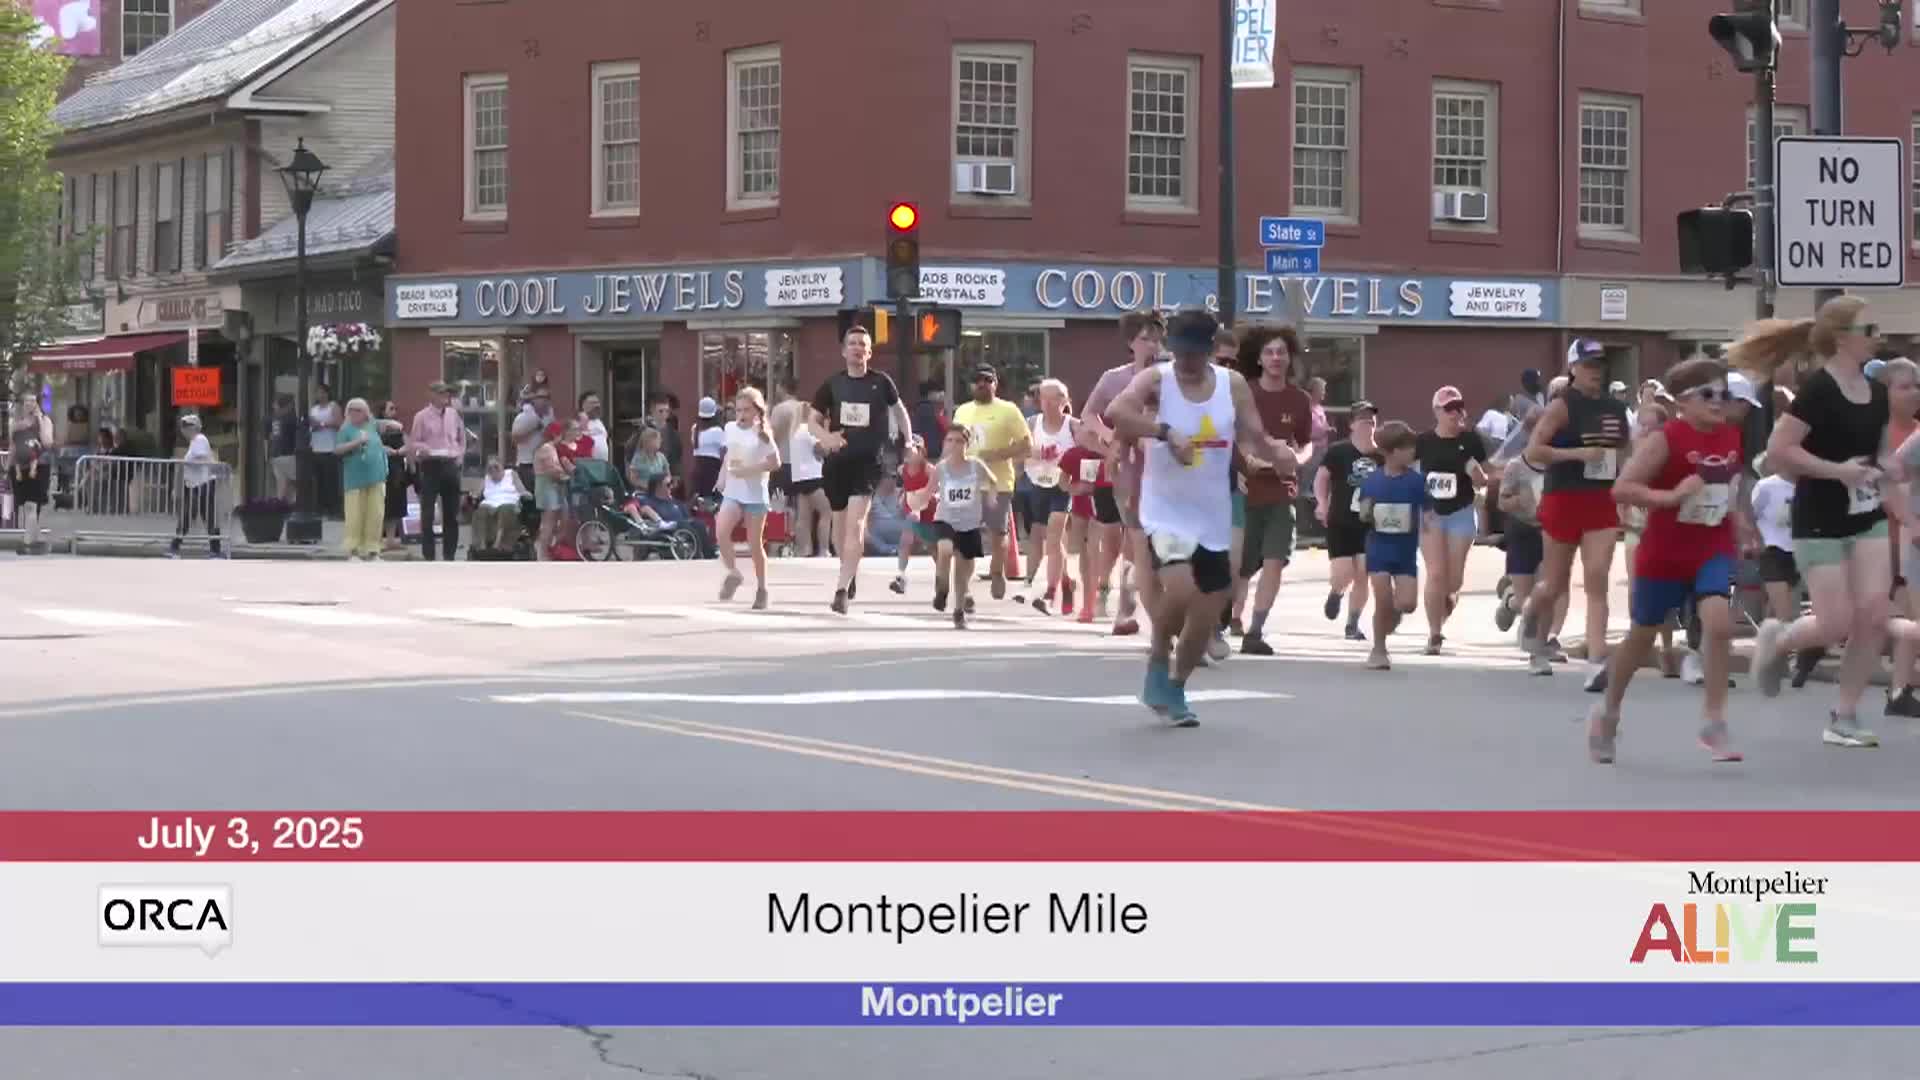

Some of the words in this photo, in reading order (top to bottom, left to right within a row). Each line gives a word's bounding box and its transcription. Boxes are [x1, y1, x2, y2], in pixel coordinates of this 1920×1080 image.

[1234, 9, 1272, 34] PEL
[1236, 36, 1270, 63] IER
[1819, 157, 1859, 184] NO
[1806, 199, 1875, 226] TURN
[1268, 223, 1302, 241] State
[1272, 255, 1299, 269] Main
[1788, 241, 1824, 268] ON
[1840, 241, 1892, 269] RED
[778, 273, 828, 286] JEWELRY
[921, 272, 948, 285] ADS
[955, 273, 998, 286] ROCKS
[475, 276, 566, 317] COOL
[583, 270, 745, 314] JEWELS
[777, 290, 798, 300] AND
[801, 287, 830, 299] GIFTS
[919, 287, 986, 300] CRYSTALS
[1035, 269, 1181, 311] COOL
[1467, 287, 1526, 299] JEWELRY
[407, 302, 447, 313] CRYSTALS
[1465, 301, 1489, 312] AND
[1494, 301, 1528, 313] GIFTS
